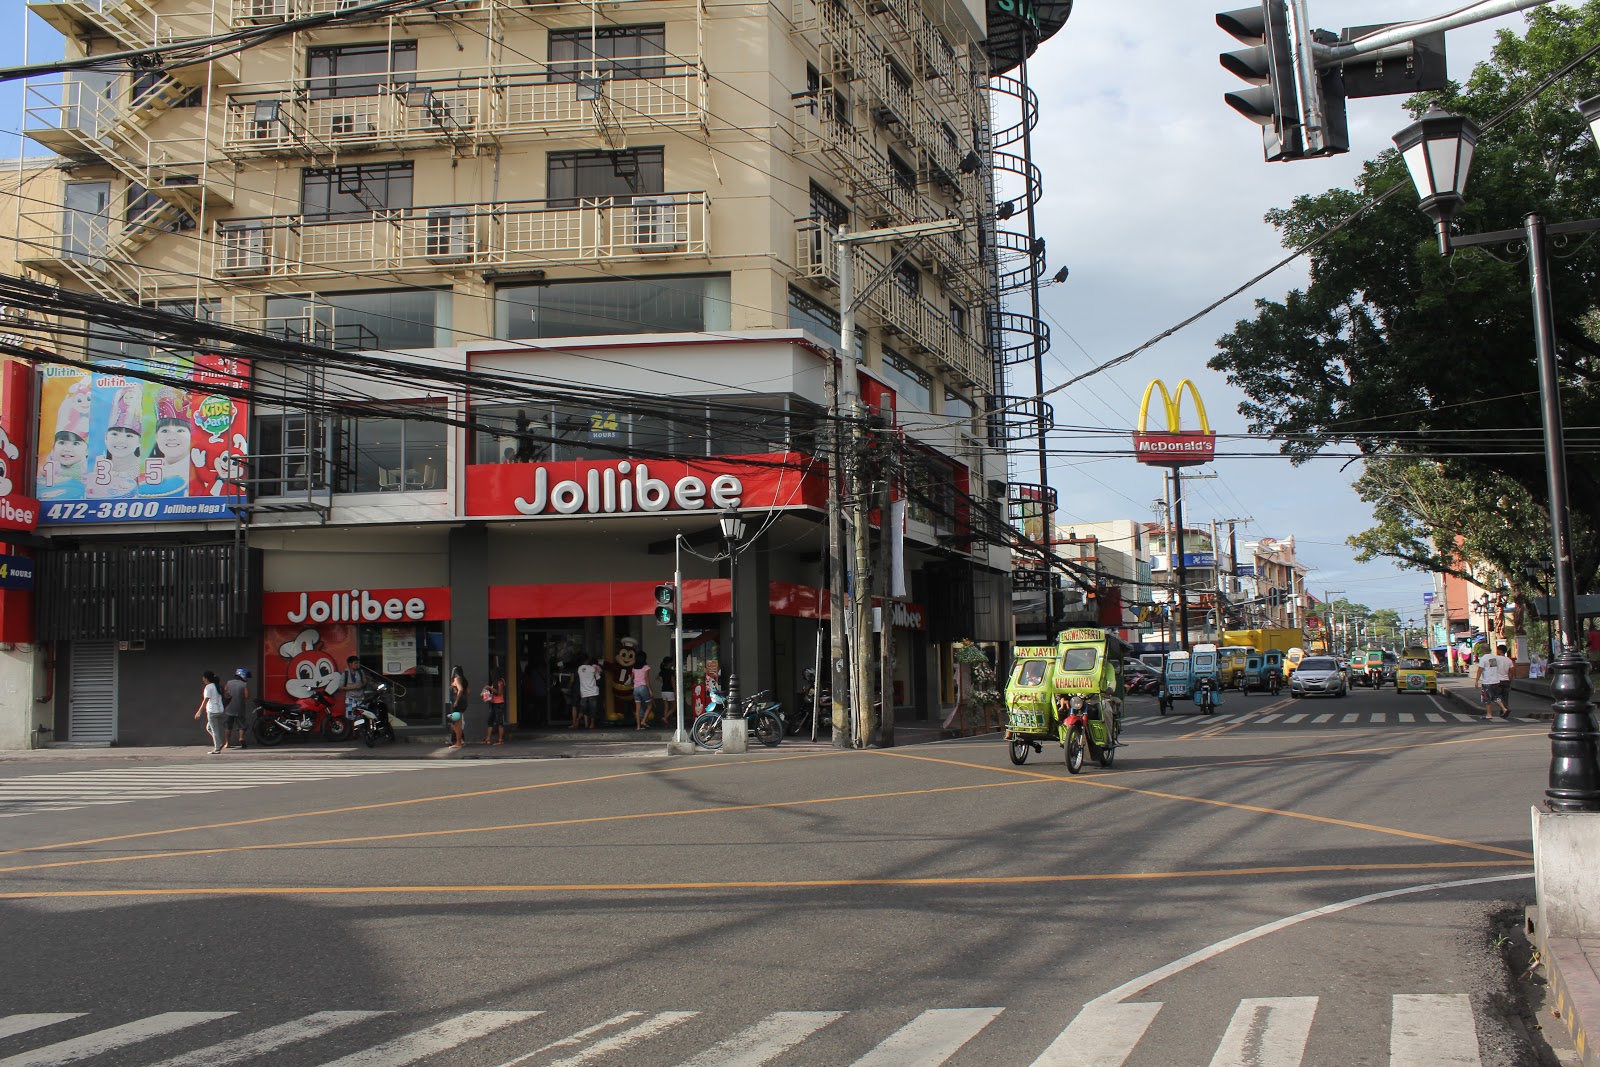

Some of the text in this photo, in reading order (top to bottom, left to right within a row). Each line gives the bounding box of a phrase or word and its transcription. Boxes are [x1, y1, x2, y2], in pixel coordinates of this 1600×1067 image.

[46, 367, 88, 377] Ulitin...
[97, 378, 137, 387] ulitin...
[590, 413, 619, 432] 24
[1139, 441, 1213, 451] McDonald's
[43, 461, 54, 487] 1
[96, 459, 112, 486] 3
[144, 458, 163, 486] 5
[514, 460, 743, 515] Jollibee
[47, 502, 160, 520] 472-3800
[163, 503, 197, 514] Jollibee
[198, 503, 219, 515] Naga
[10, 568, 32, 579] HOURS
[287, 589, 426, 623] Jollibee
[1016, 648, 1031, 657] JAY
[1033, 648, 1048, 657] JAY
